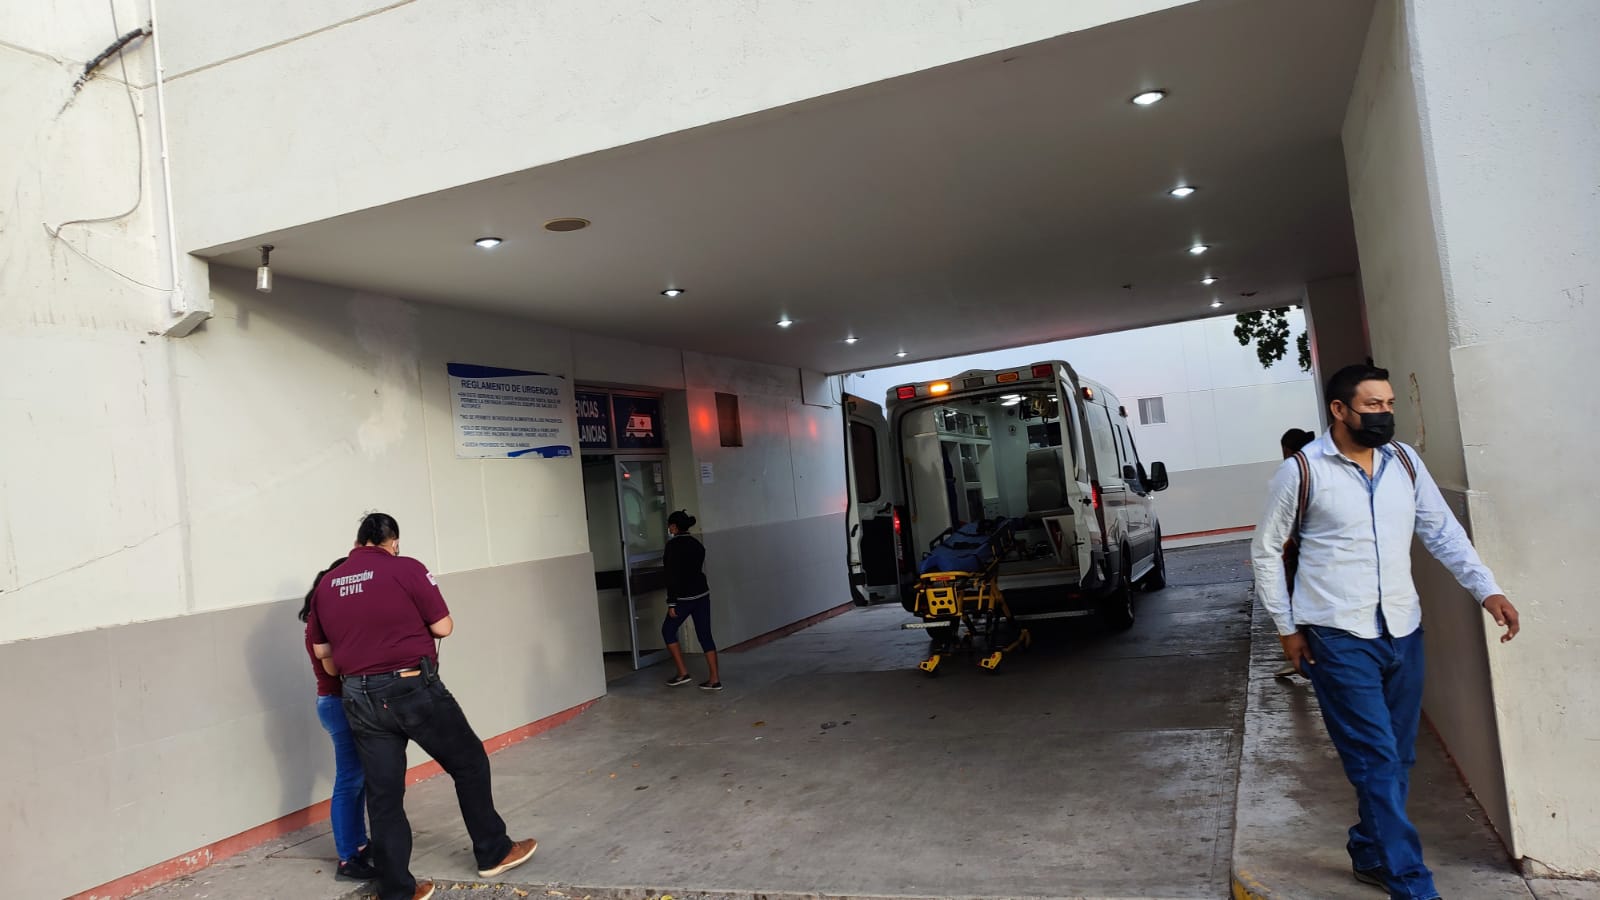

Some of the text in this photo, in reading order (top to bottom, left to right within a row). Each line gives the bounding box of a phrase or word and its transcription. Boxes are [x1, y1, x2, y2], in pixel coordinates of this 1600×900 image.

[461, 380, 558, 397] REGLAMENTO DE URGENCIAS
[331, 570, 374, 588] PROTECCIÓN
[339, 583, 364, 597] CIVIL
